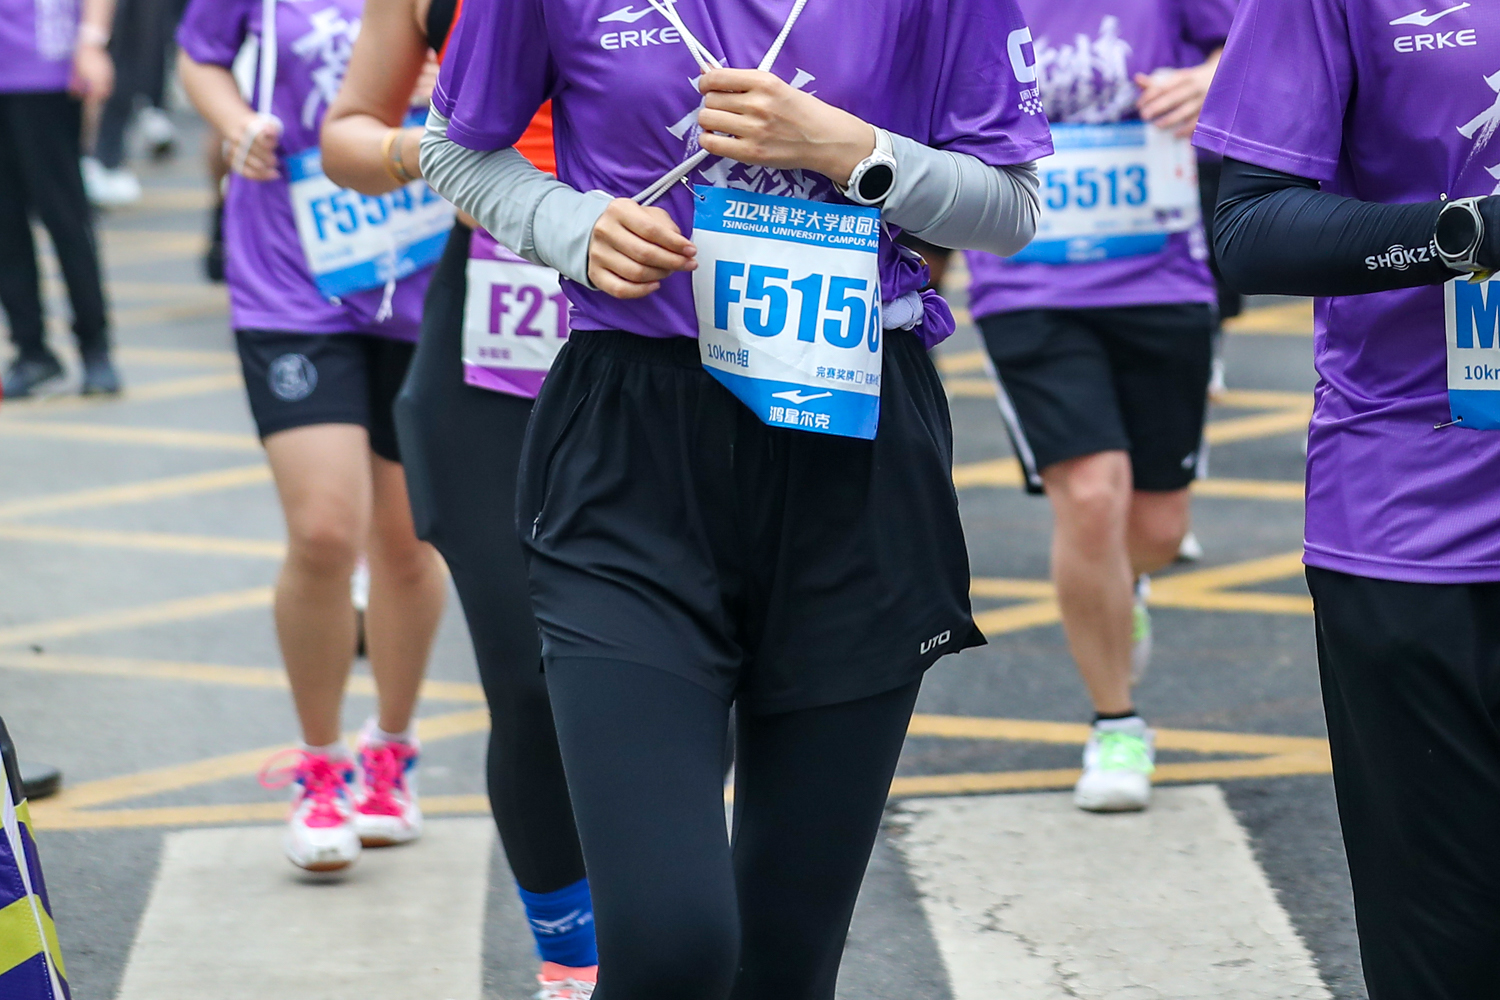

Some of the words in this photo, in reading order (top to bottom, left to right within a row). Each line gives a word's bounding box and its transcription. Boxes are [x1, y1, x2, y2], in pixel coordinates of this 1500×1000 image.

[600, 26, 681, 51] ERKE
[1393, 28, 1477, 53] ERKE
[1038, 165, 1148, 211] 5513
[722, 219, 770, 234] TSINGHUA
[772, 226, 827, 242] UNIVERSITY
[827, 234, 866, 247] CAMPUS
[1364, 244, 1431, 271] SHOKZ
[714, 259, 880, 354] F5156
[706, 343, 750, 368] 10km组
[816, 366, 855, 382] 完赛奖牌
[768, 405, 831, 430] 鸿星尔克
[920, 629, 951, 655] UTO
